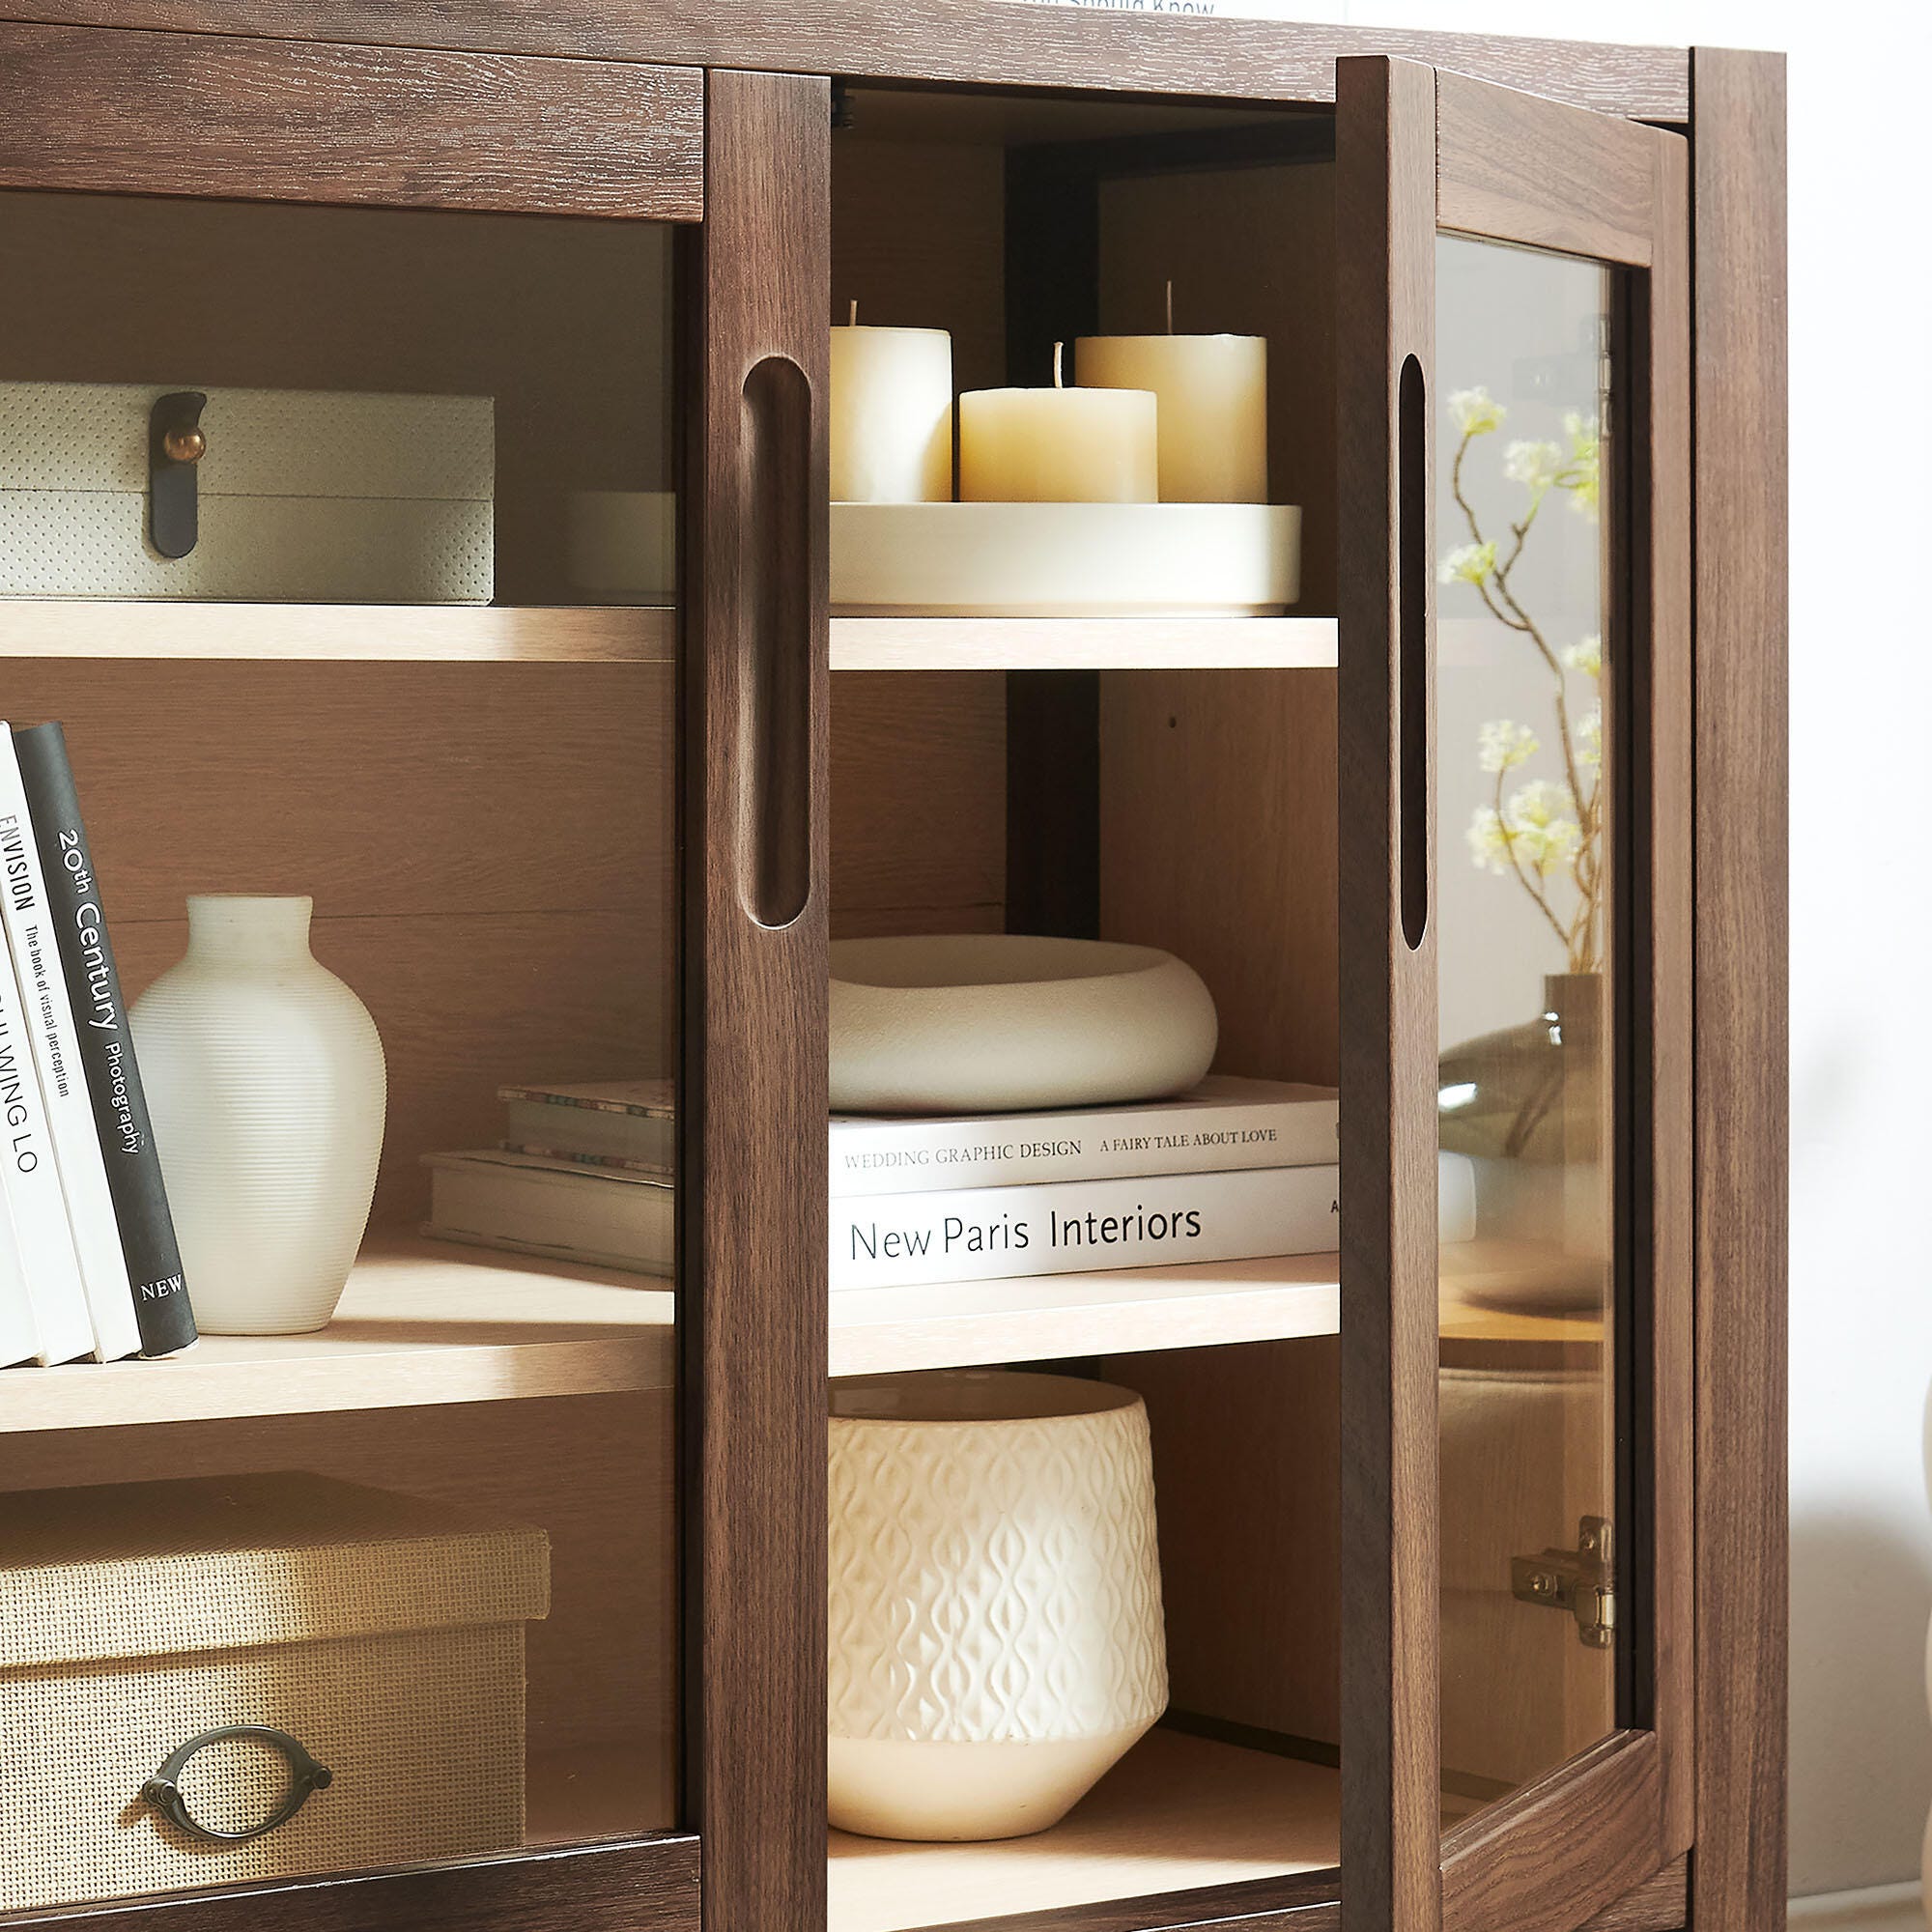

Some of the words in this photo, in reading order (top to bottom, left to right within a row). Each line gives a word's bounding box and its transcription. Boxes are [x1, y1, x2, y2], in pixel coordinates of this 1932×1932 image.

[0, 814, 36, 911] ENVISION
[58, 829, 93, 895] 20th
[25, 924, 40, 948] The
[30, 949, 46, 979] book
[75, 902, 118, 1030] Century
[37, 980, 50, 992] of
[40, 994, 58, 1030] visual
[44, 1033, 70, 1097] perception
[104, 1041, 141, 1154] Photography
[13, 1133, 38, 1173] LO
[844, 1150, 930, 1170] WEDDING
[935, 1144, 1014, 1164] GRAPHIC
[1019, 1140, 1082, 1159] DESIGN
[1099, 1140, 1110, 1152] A
[1113, 1137, 1152, 1151] FAIRY
[1153, 1134, 1189, 1150] TALE
[1193, 1131, 1239, 1147] ABOUT
[1241, 1128, 1277, 1144] LOVE
[851, 1222, 931, 1260] New
[944, 1213, 1030, 1254] Paris
[1051, 1204, 1202, 1247] Interiors
[140, 1274, 182, 1301] NEW
